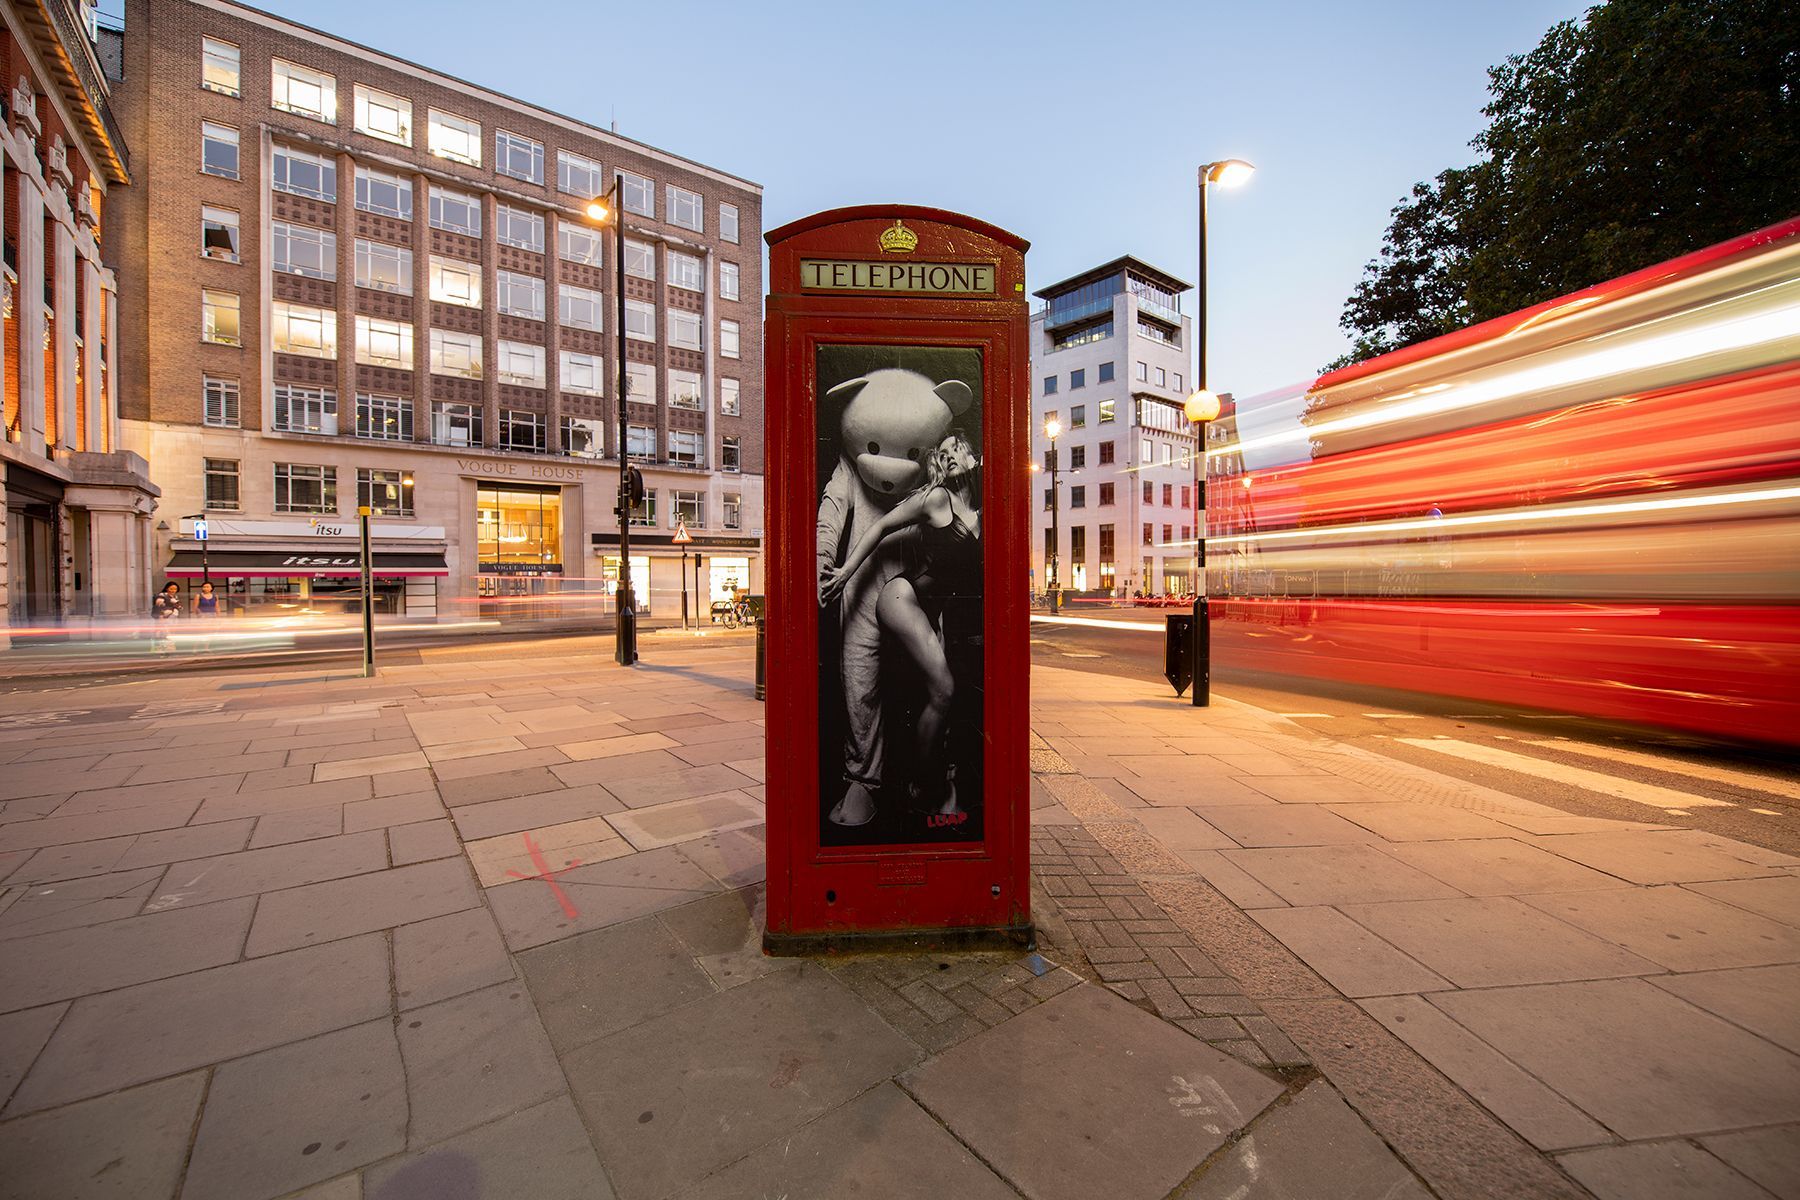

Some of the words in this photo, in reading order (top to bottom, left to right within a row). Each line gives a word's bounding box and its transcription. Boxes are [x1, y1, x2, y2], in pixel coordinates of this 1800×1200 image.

[808, 263, 987, 291] TELEPHONE
[457, 460, 518, 475] VOGUE
[531, 466, 584, 480] HOUSE
[316, 525, 342, 536] itsu
[283, 556, 356, 565] itsu
[927, 812, 968, 828] LUAP
